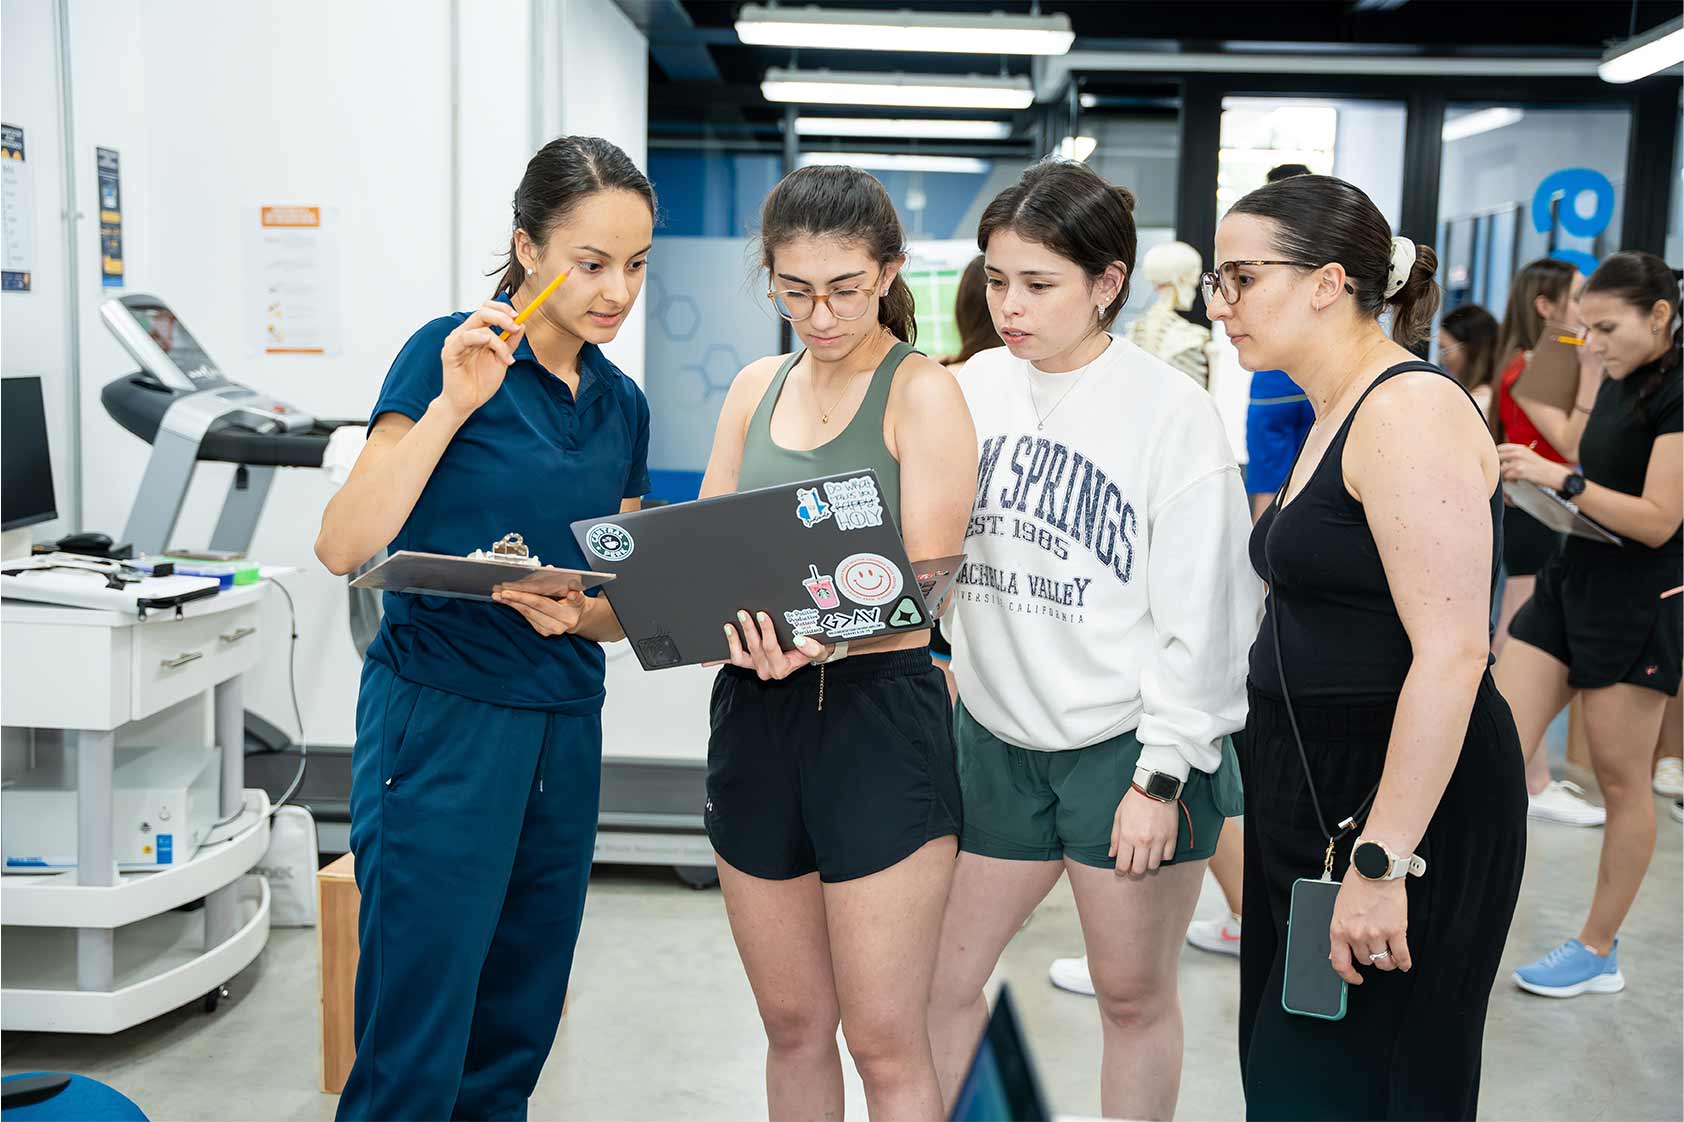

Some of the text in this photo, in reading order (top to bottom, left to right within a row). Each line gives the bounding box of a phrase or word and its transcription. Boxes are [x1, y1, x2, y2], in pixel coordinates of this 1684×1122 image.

[976, 435, 1007, 508] M
[1000, 435, 1137, 583] SPRINGS
[592, 527, 624, 542] CENTRAL
[1012, 518, 1069, 560] 1985
[604, 549, 627, 559] PERK
[956, 563, 1091, 607] ACHELLA VALLEY
[1009, 601, 1084, 624] CALIFORNIA
